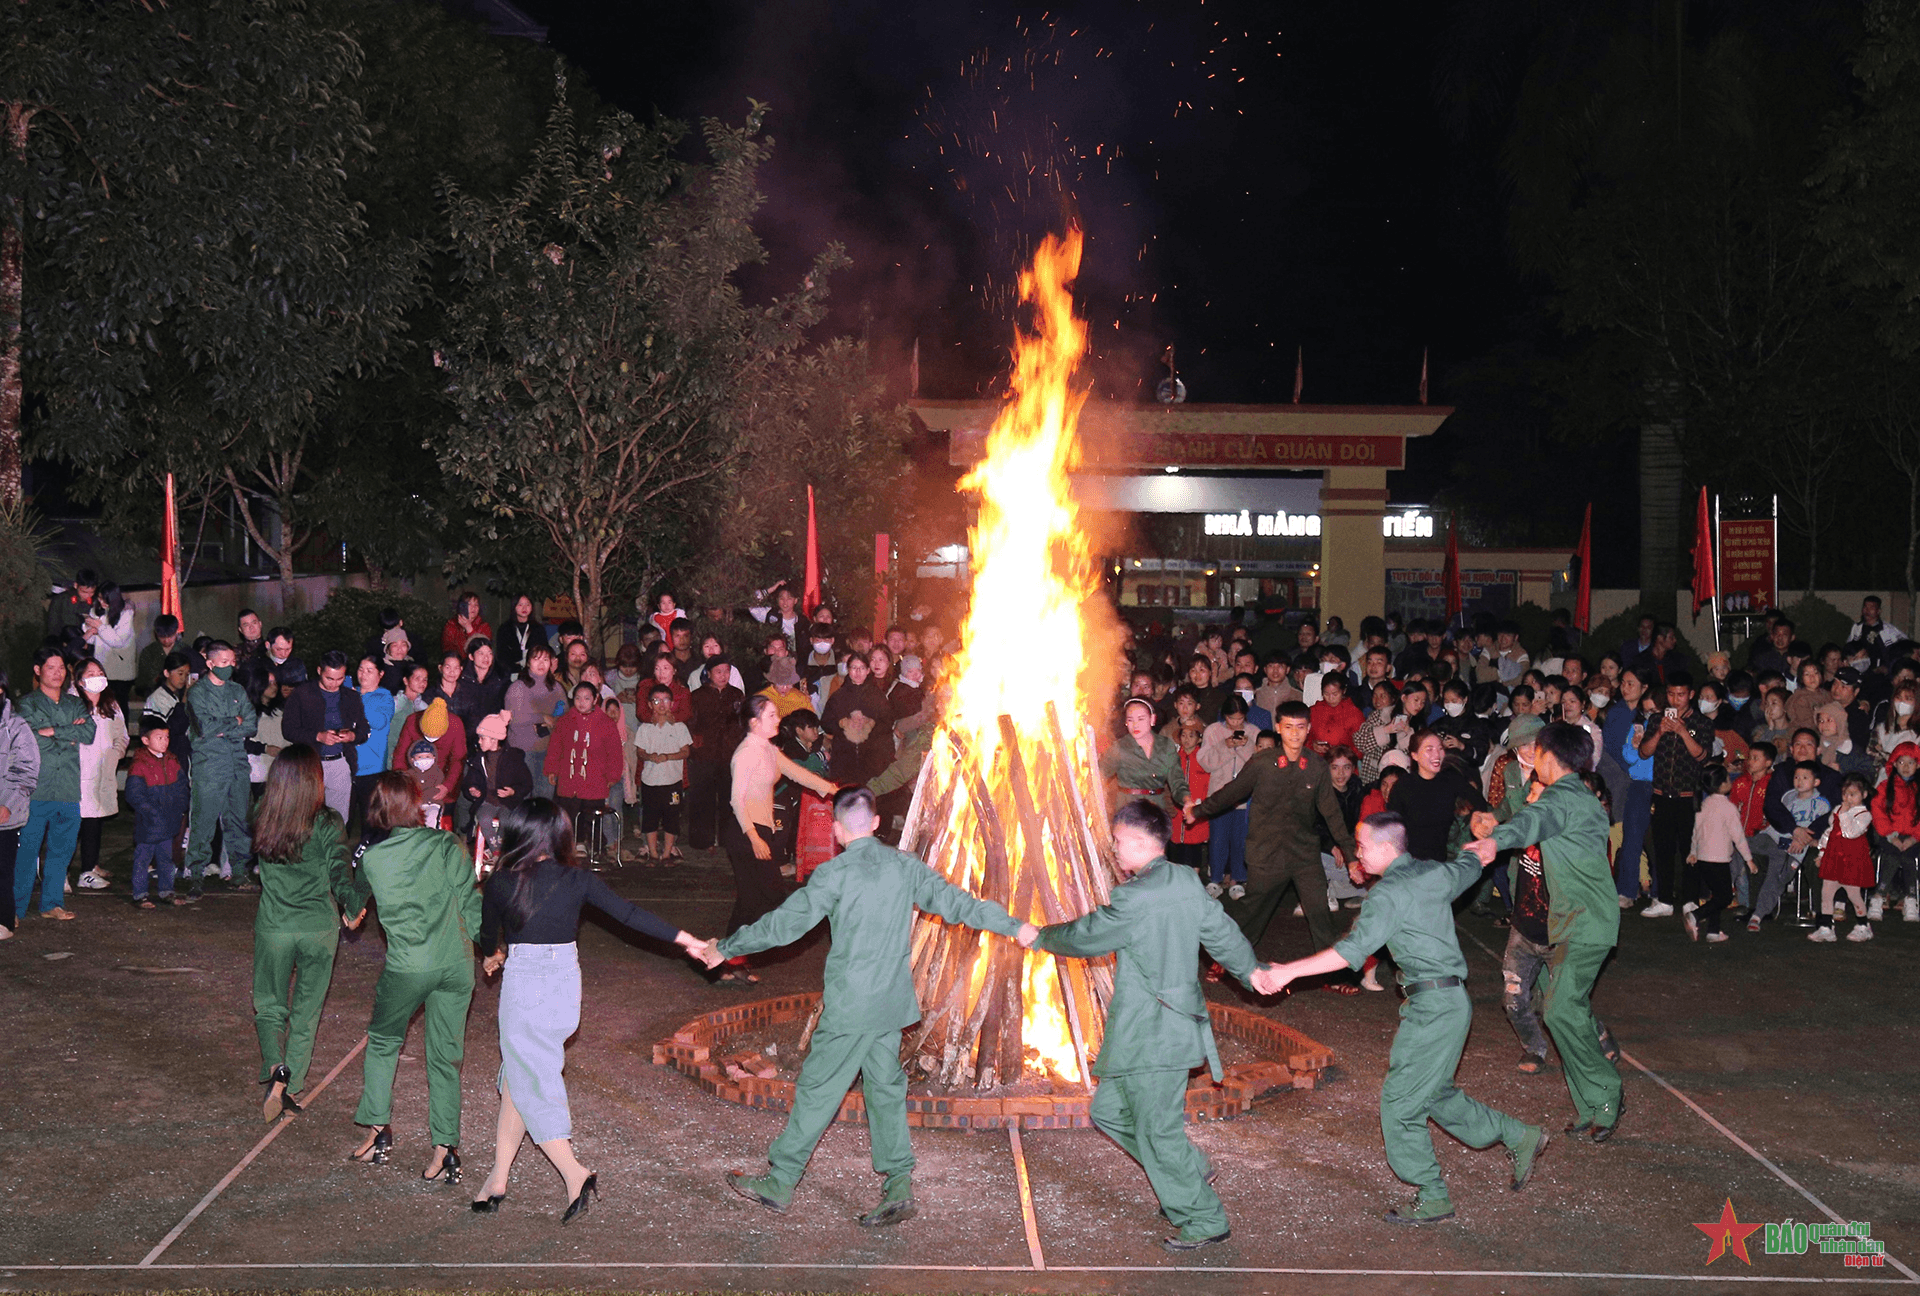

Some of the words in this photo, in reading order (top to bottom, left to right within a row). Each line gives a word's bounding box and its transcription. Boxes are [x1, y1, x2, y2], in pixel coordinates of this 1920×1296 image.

[1274, 437, 1332, 459] QUÂN
[1204, 509, 1253, 536] NHÀ
[1257, 510, 1321, 537] HÀNG
